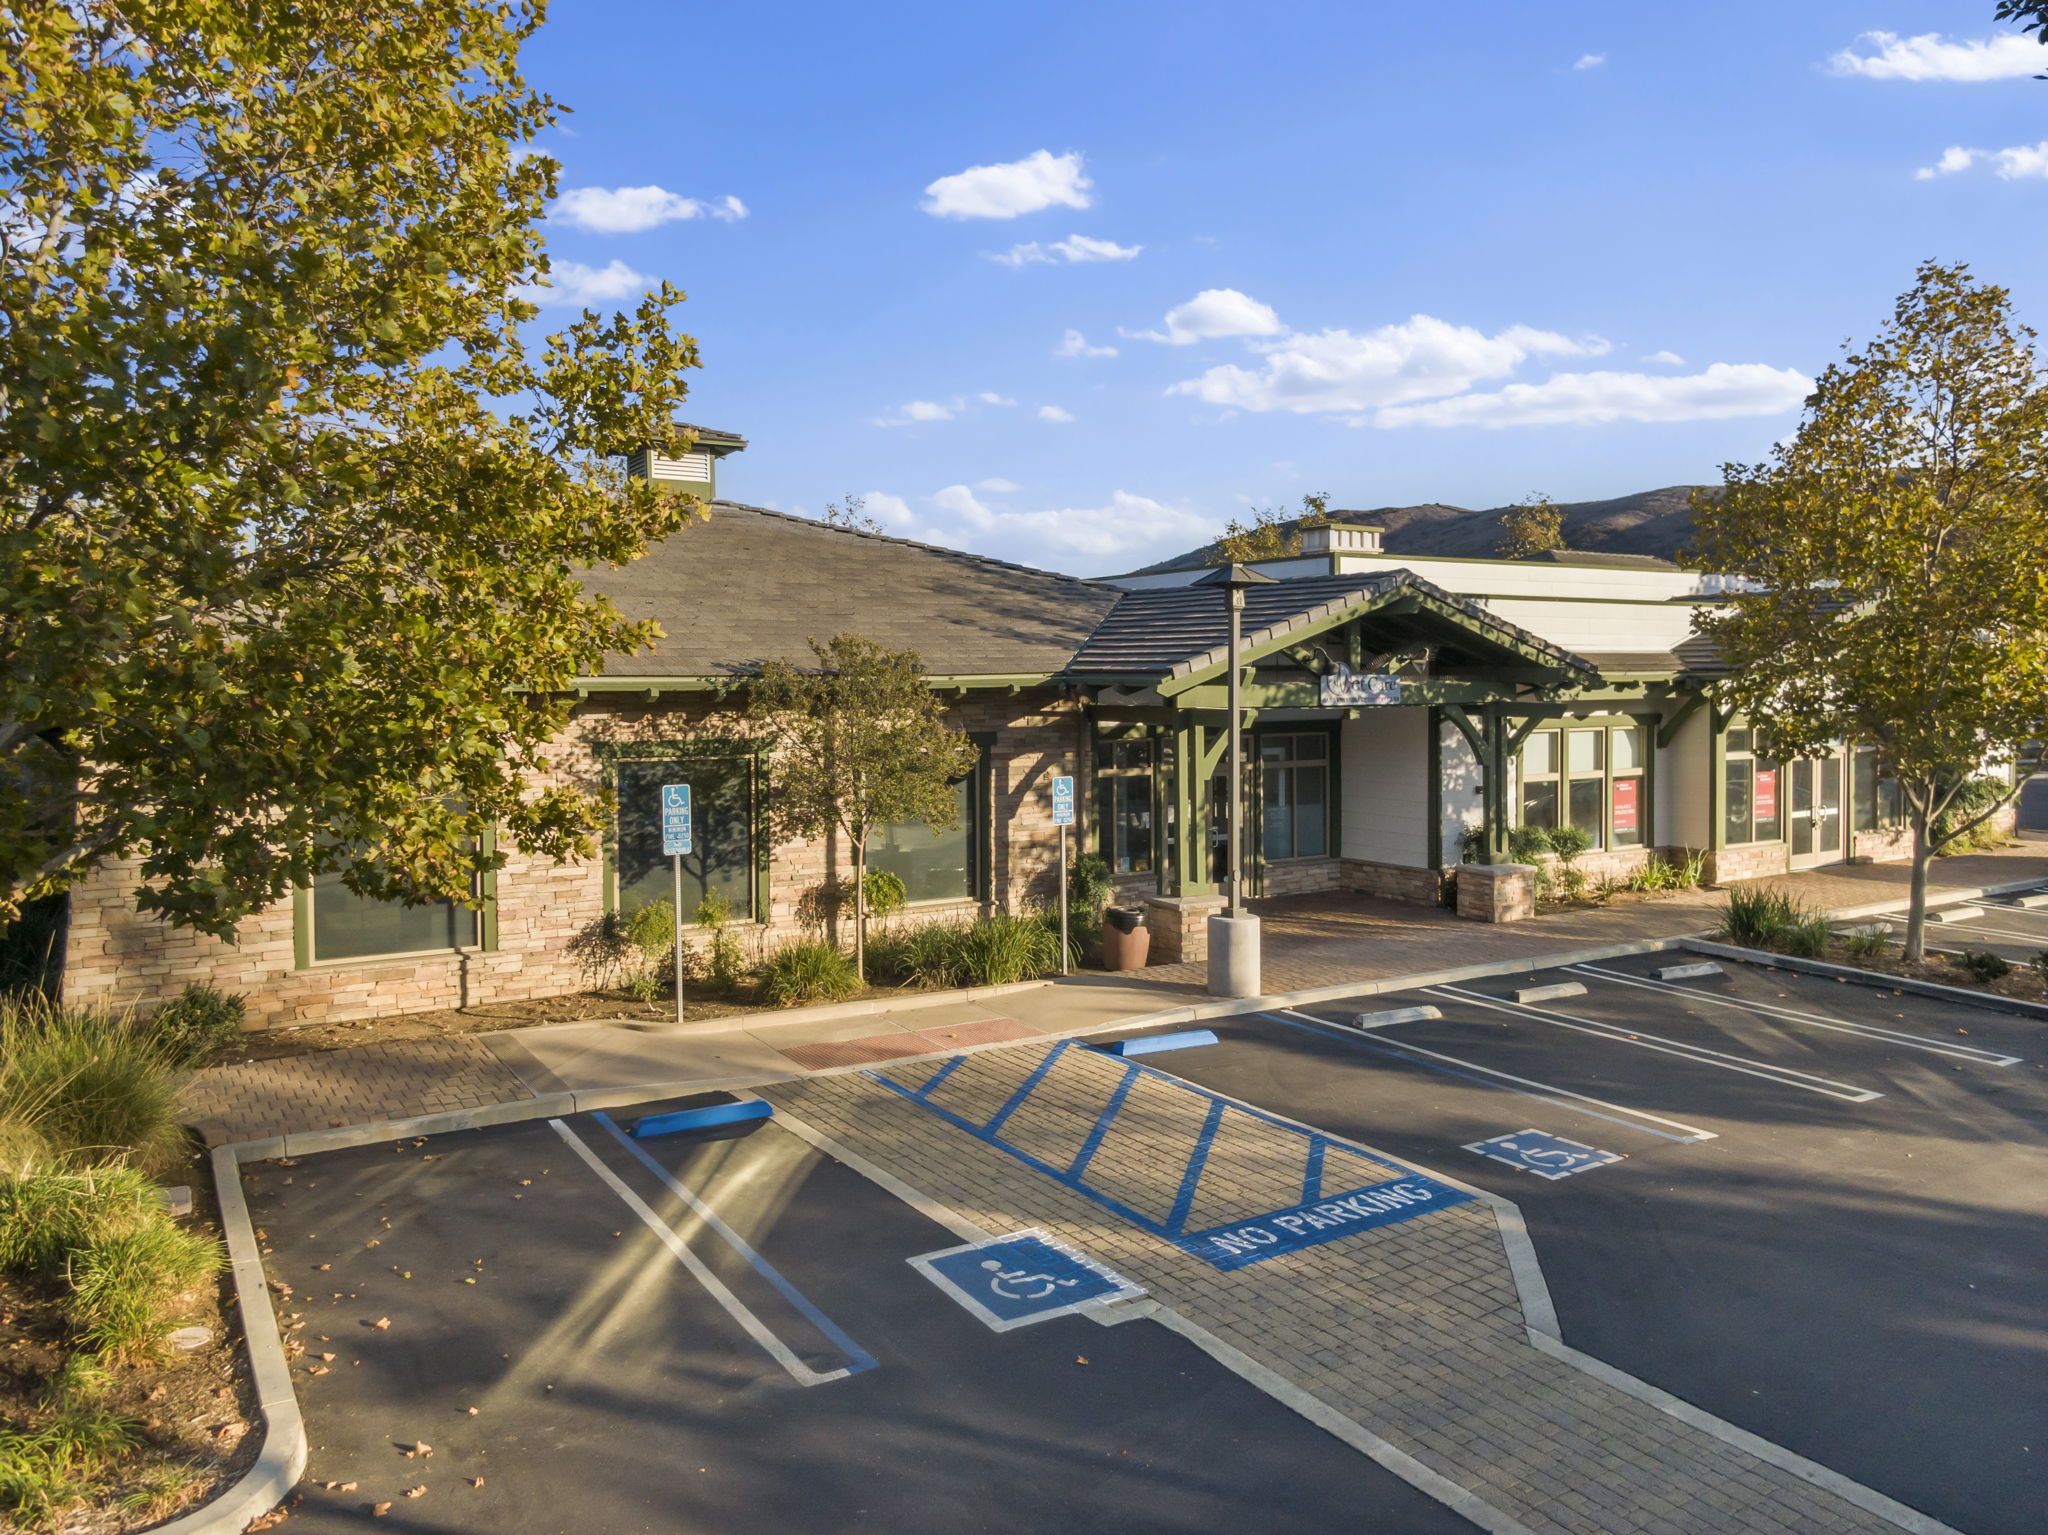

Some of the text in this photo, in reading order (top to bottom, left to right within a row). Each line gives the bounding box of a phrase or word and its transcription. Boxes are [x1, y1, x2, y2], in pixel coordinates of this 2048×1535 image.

[1368, 677, 1397, 691] Care
[664, 807, 689, 816] PARKING
[669, 816, 684, 825] ONLY
[1207, 1183, 1433, 1254] NO PARKING
